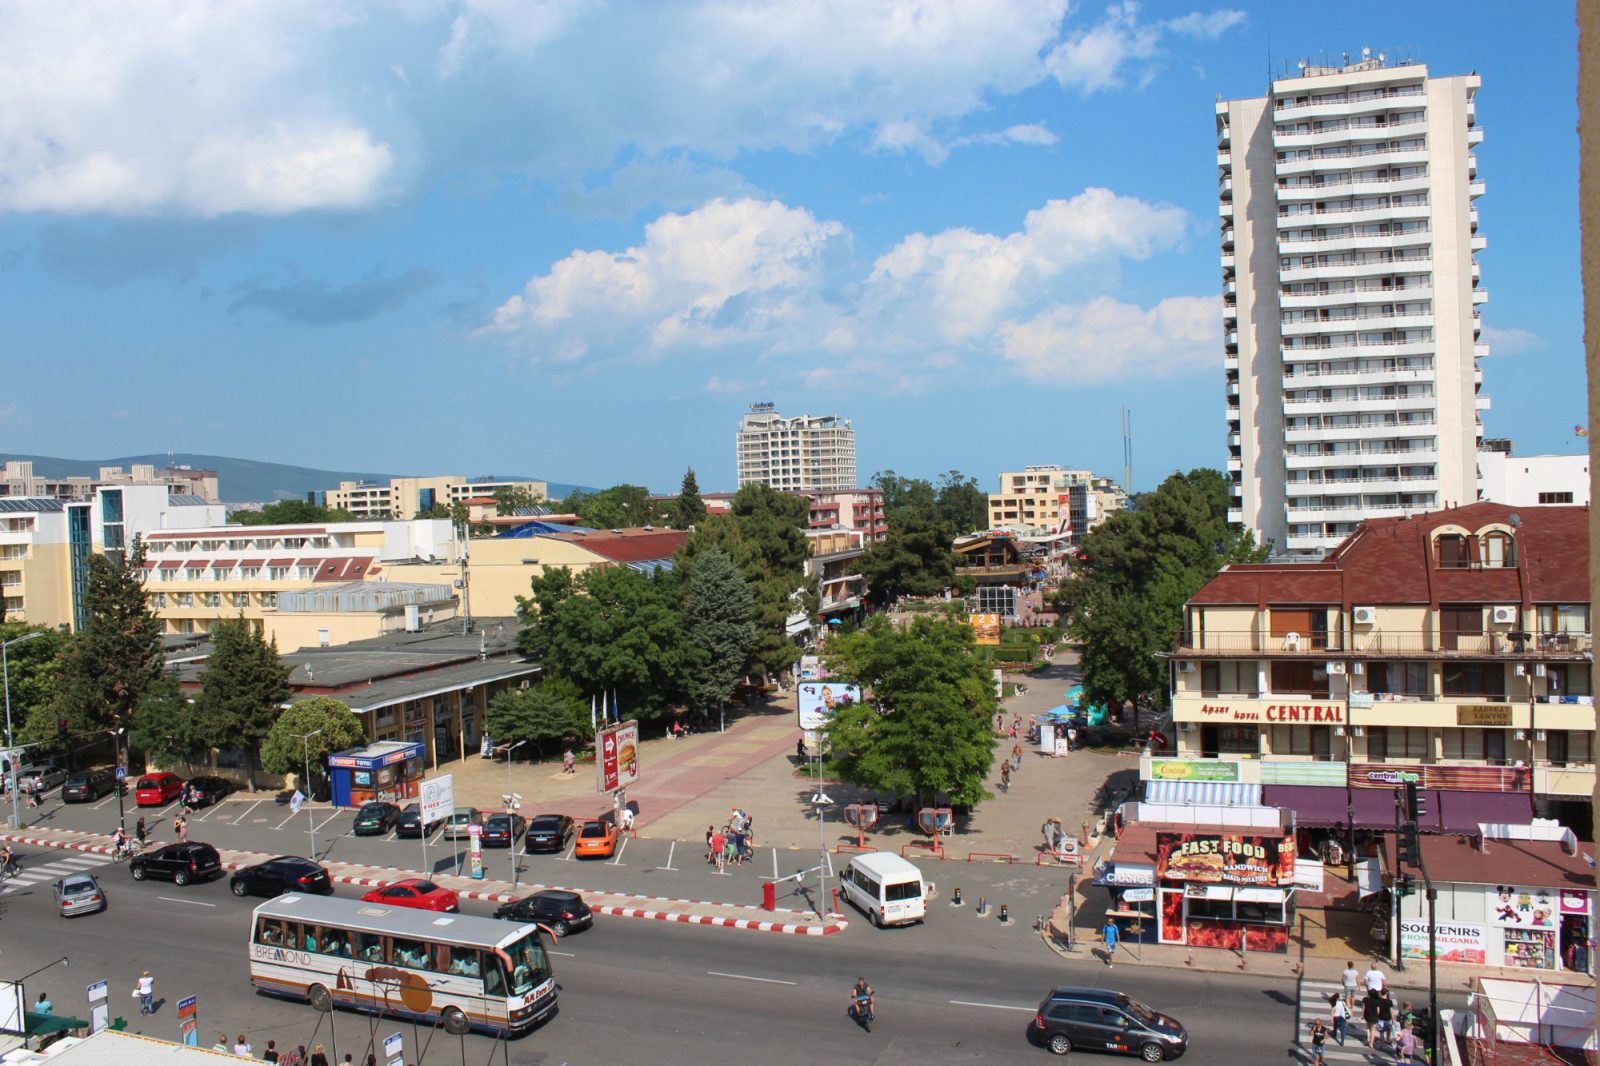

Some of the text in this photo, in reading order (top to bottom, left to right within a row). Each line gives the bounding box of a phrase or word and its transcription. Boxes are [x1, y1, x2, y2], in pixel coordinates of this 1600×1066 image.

[978, 614, 985, 624] 2
[990, 614, 997, 624] 3
[1266, 705, 1343, 722] CENTRAL
[1181, 840, 1265, 859] FAST FOOD
[1223, 863, 1268, 873] SANDWICH
[1106, 873, 1153, 884] CHANGE
[1434, 936, 1479, 945] ULGARIA
